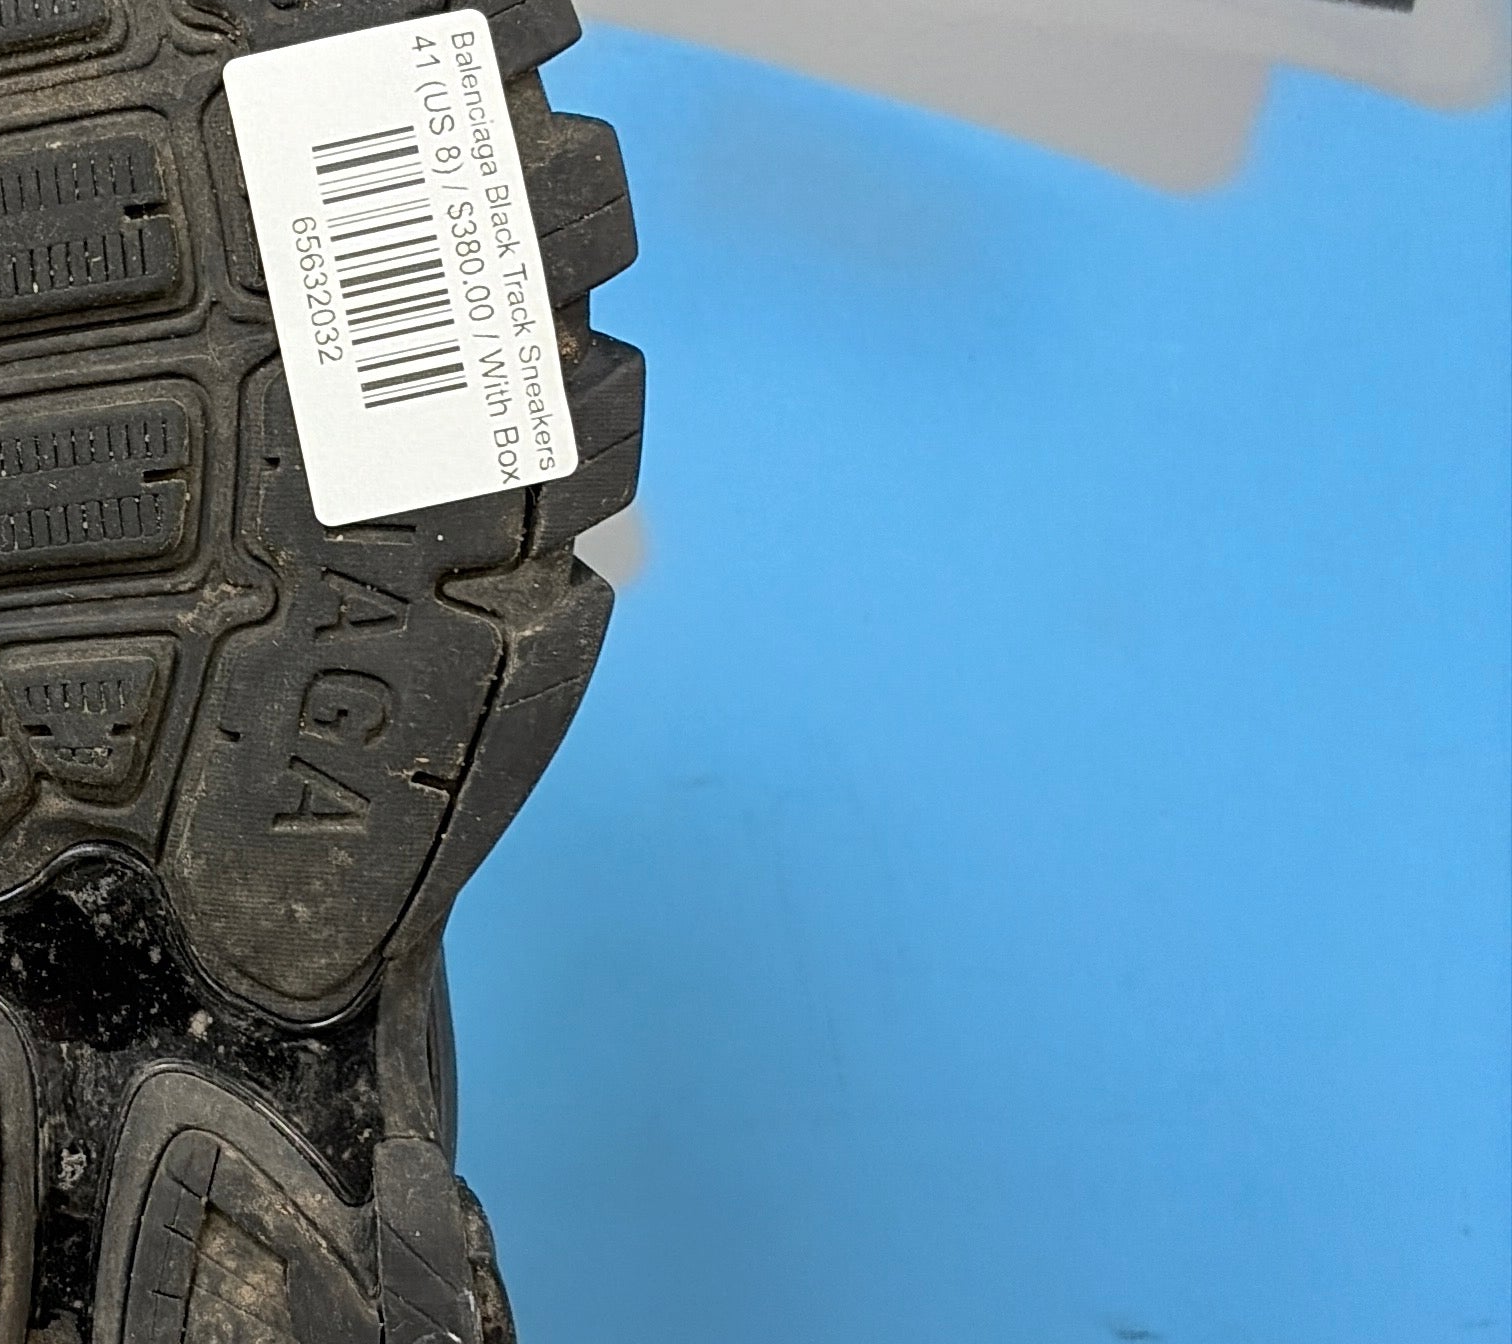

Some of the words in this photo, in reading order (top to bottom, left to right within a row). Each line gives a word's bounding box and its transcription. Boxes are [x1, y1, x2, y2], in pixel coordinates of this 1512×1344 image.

[412, 35, 441, 68] 41
[414, 81, 455, 135] (US
[451, 31, 497, 176] Balenciaga
[431, 146, 464, 174] 8)
[485, 184, 521, 258] Black
[292, 216, 343, 365] 65632032
[446, 201, 495, 321] $380.00
[503, 262, 536, 337] Track
[478, 348, 512, 417] With
[518, 345, 556, 471] Sneakers
[493, 426, 521, 485] Box
